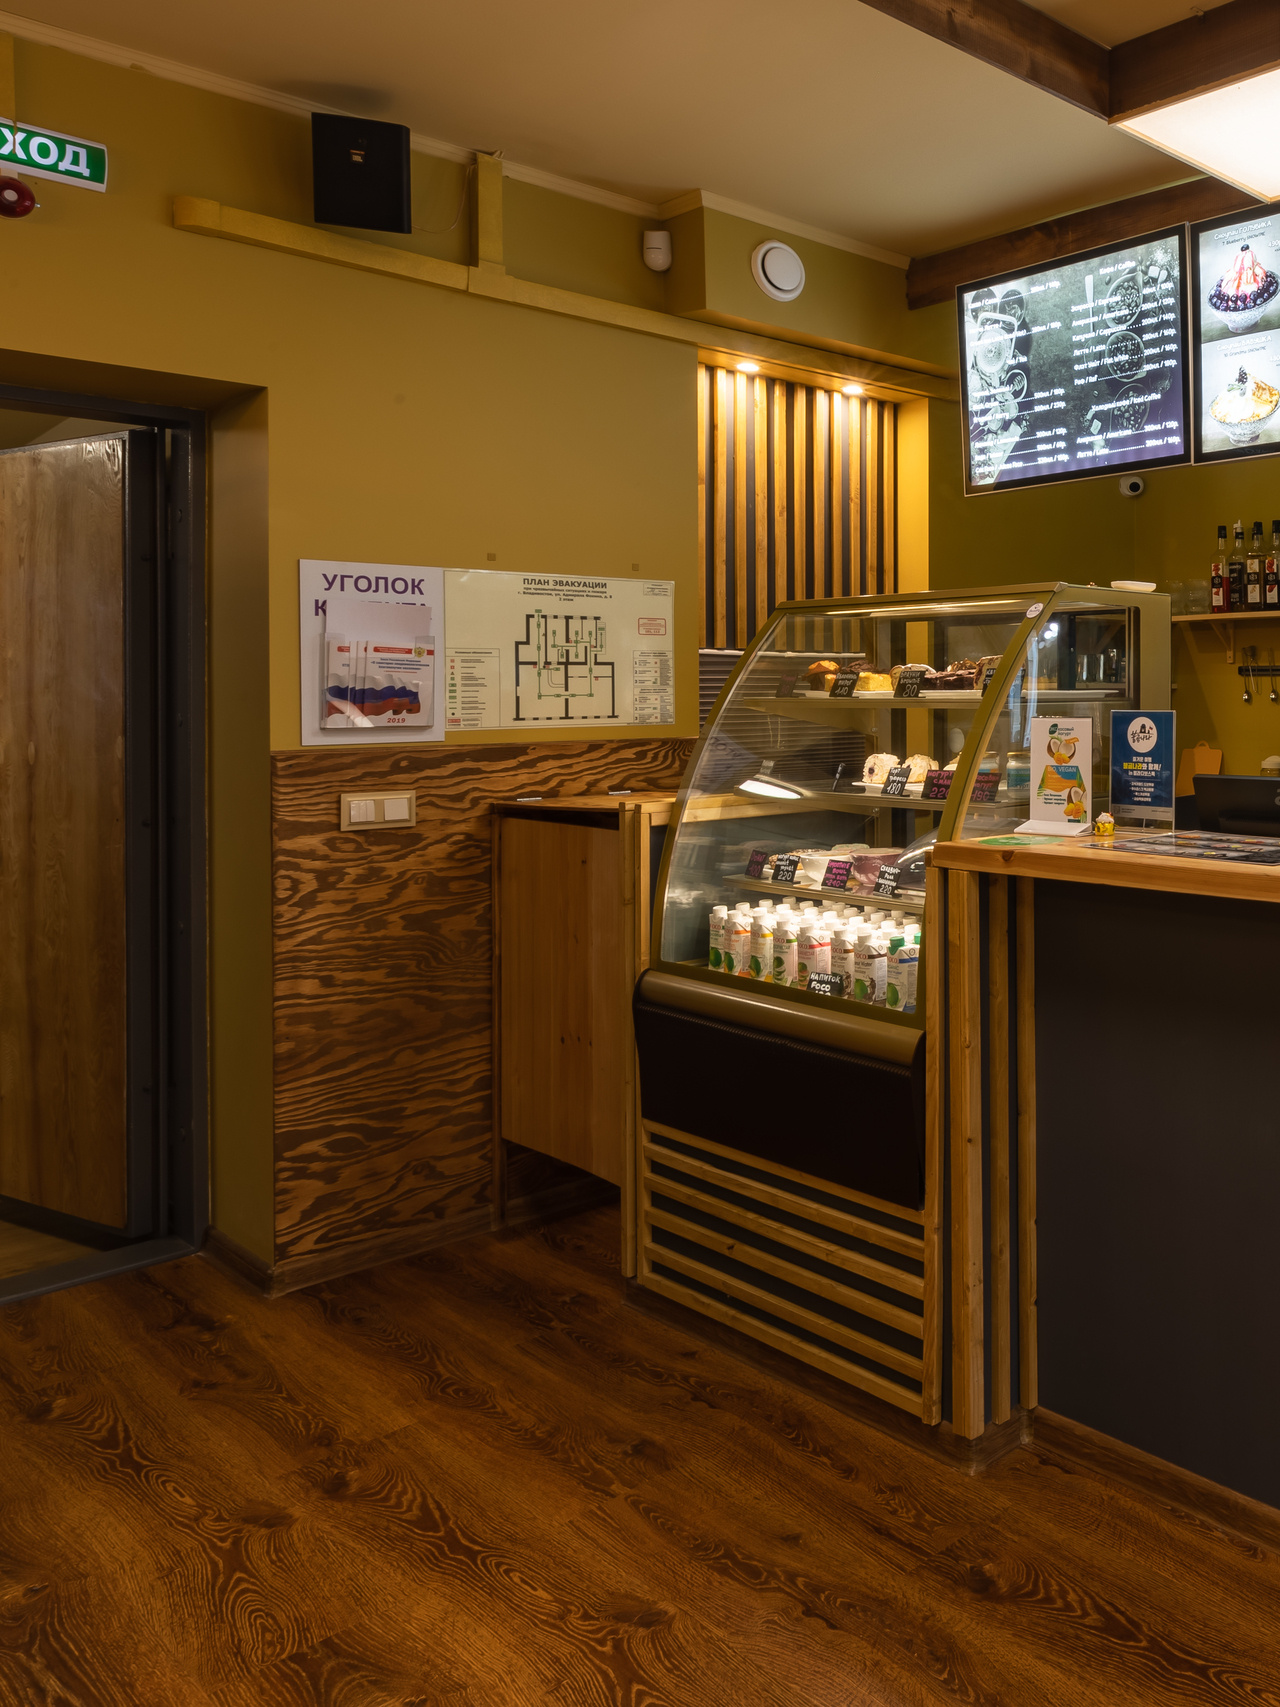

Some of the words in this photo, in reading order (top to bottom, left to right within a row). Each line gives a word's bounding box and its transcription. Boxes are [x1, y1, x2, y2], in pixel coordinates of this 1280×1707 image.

[1145, 393, 1161, 402] Coffee
[322, 573, 425, 595] УГОЛОК
[523, 578, 550, 586] ПЛАН
[553, 580, 607, 589] ЭВАКУАЦИИ
[903, 684, 917, 697] 80
[778, 871, 792, 880] 220
[810, 972, 841, 983] НАПИТОК
[811, 981, 831, 991] FOCO
